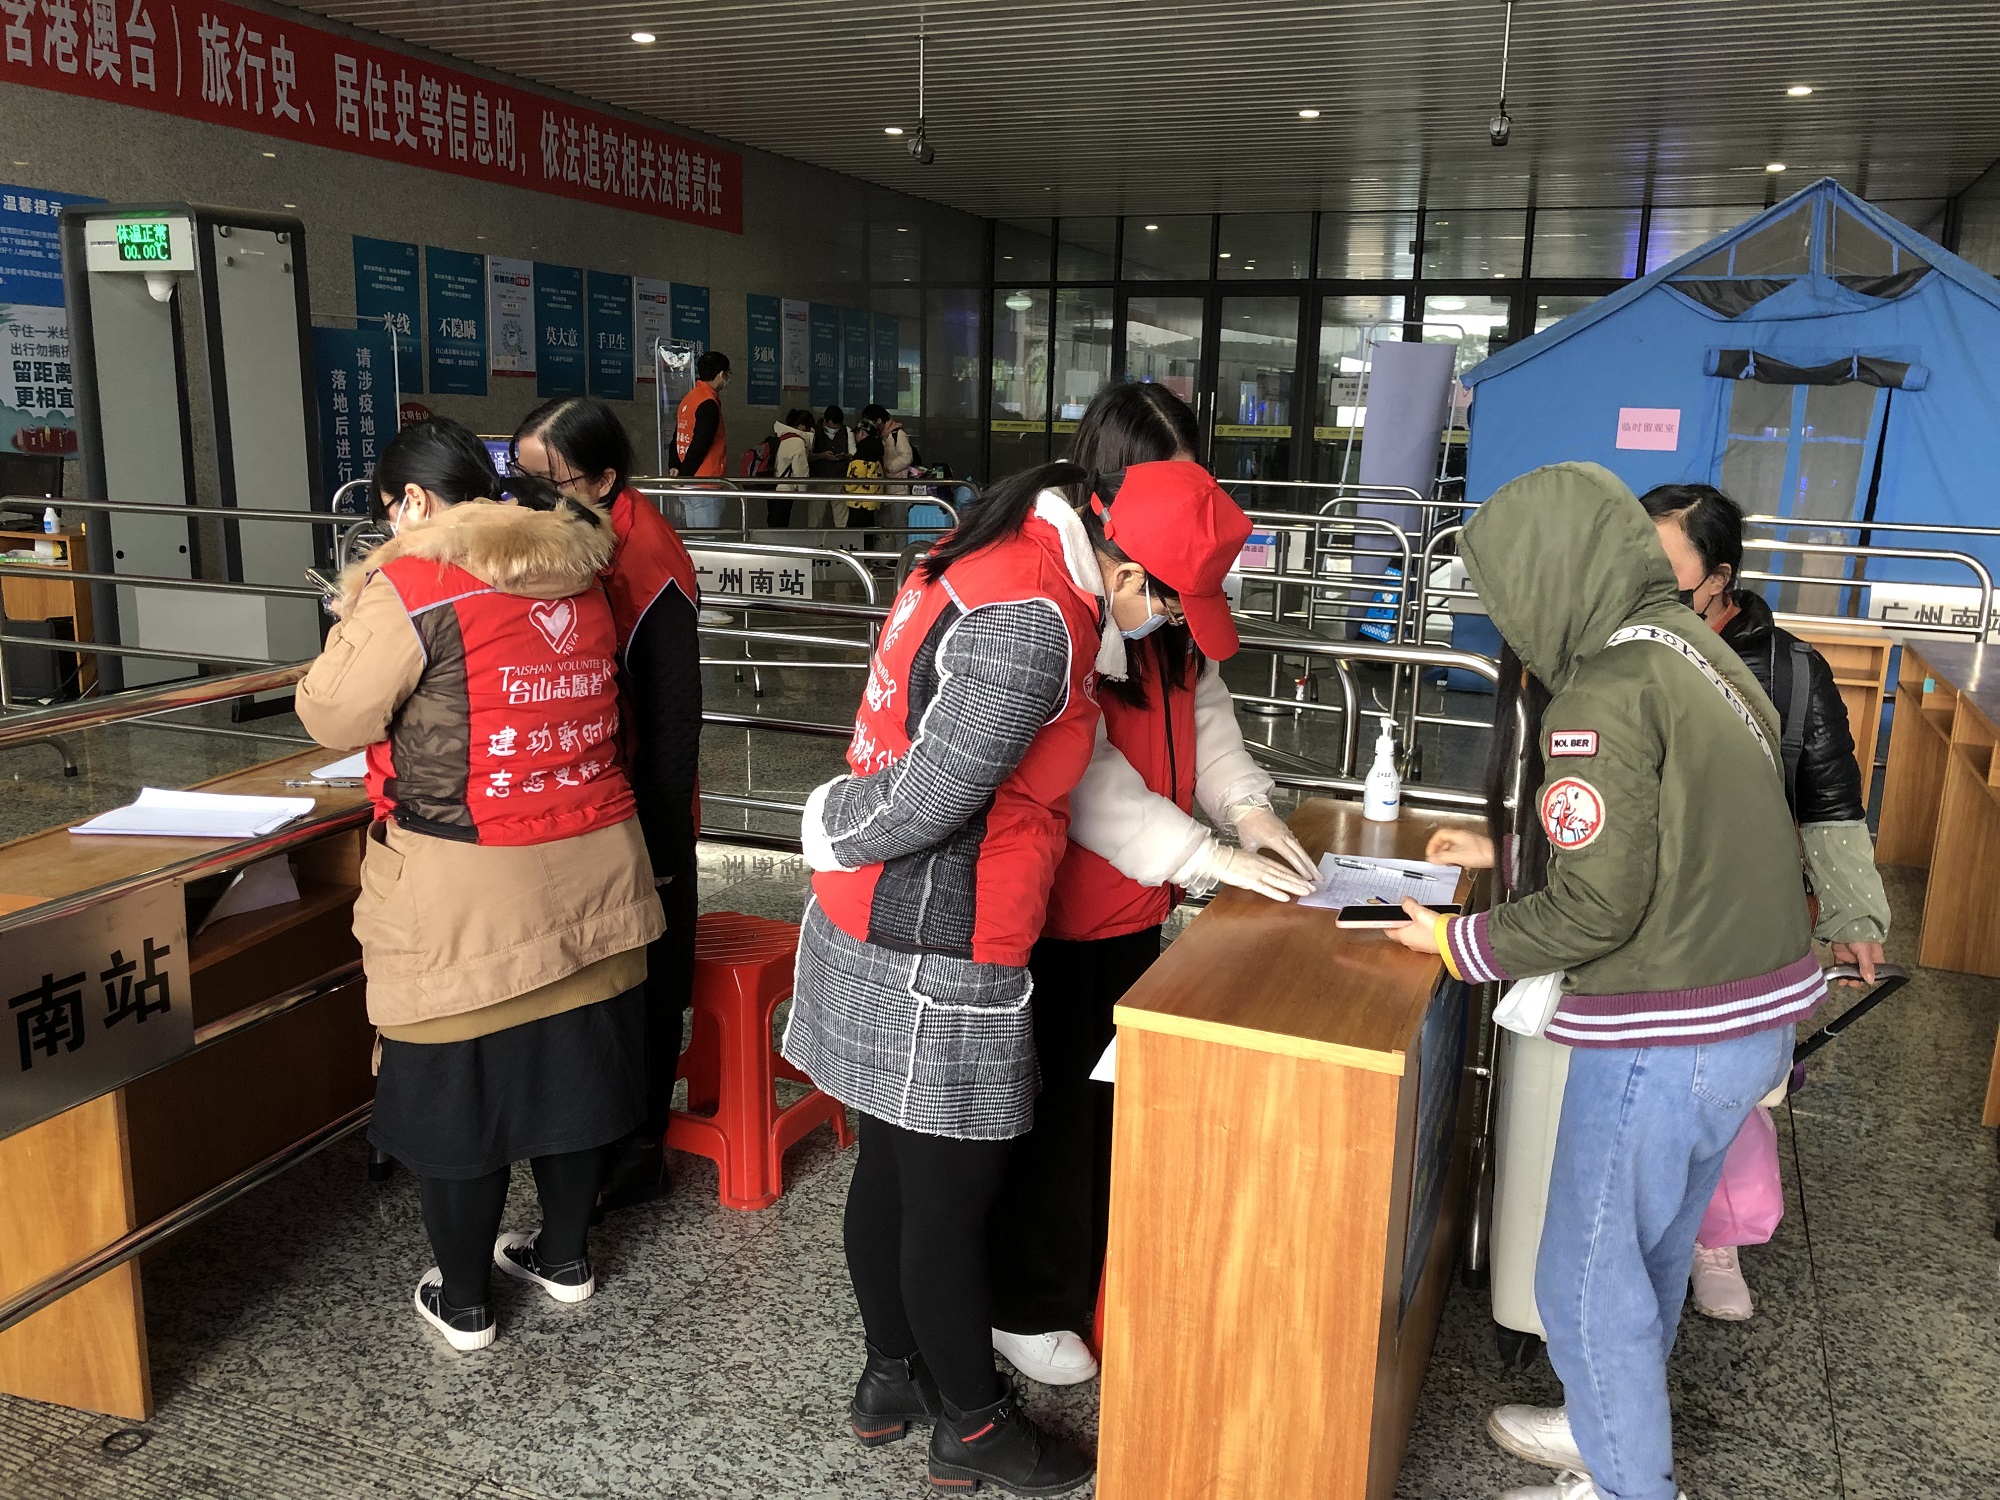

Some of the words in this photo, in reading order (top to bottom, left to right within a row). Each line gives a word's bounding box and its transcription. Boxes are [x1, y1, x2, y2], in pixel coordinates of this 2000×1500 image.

[2, 194, 62, 217] 温馨提示
[117, 223, 167, 244] 体温正常
[438, 317, 477, 340] 不隐瞒
[545, 325, 578, 347] 莫大意
[596, 332, 626, 350] 手卫生
[753, 345, 775, 363] 多通风
[13, 360, 72, 383] 留距离
[15, 385, 75, 409] 更相宜
[1621, 421, 1675, 433] 临时留观室
[563, 631, 579, 656] TSVA
[498, 663, 552, 692] TAISHAN
[557, 658, 612, 681] VOLUNTEER
[509, 672, 603, 705] 台山志愿者
[1571, 738, 1590, 748] BER
[8, 937, 171, 1072] 南站
